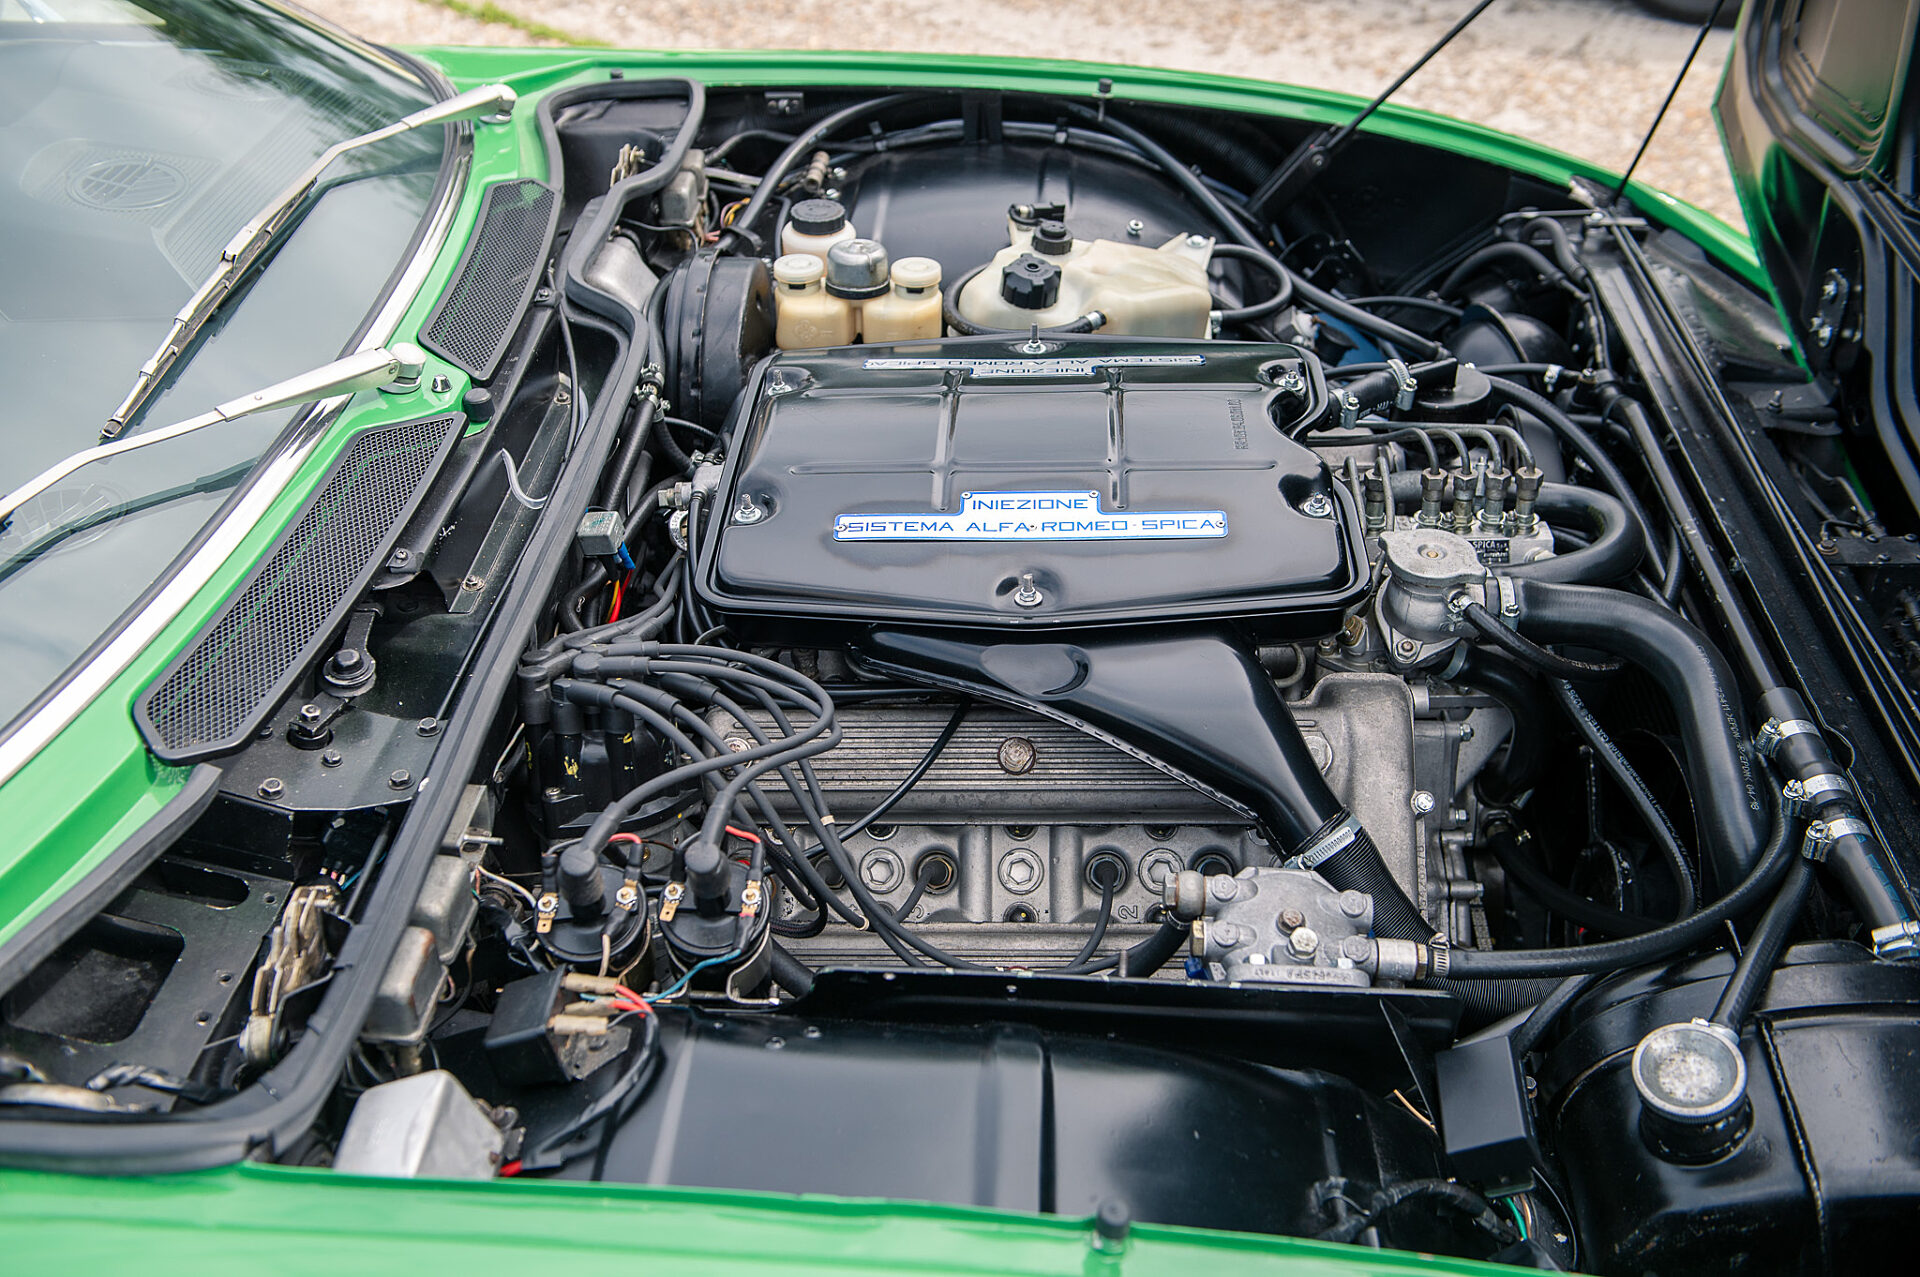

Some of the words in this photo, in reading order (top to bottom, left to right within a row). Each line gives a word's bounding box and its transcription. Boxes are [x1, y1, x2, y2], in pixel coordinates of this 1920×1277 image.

[972, 499, 1088, 511] INIEZIONE
[847, 521, 954, 533] SISTEMA
[966, 521, 1030, 533] ALFA
[1041, 519, 1128, 532] ROMEO
[1141, 519, 1215, 530] SPICA
[1472, 540, 1496, 549] SPICA
[1585, 713, 1610, 742] GATES
